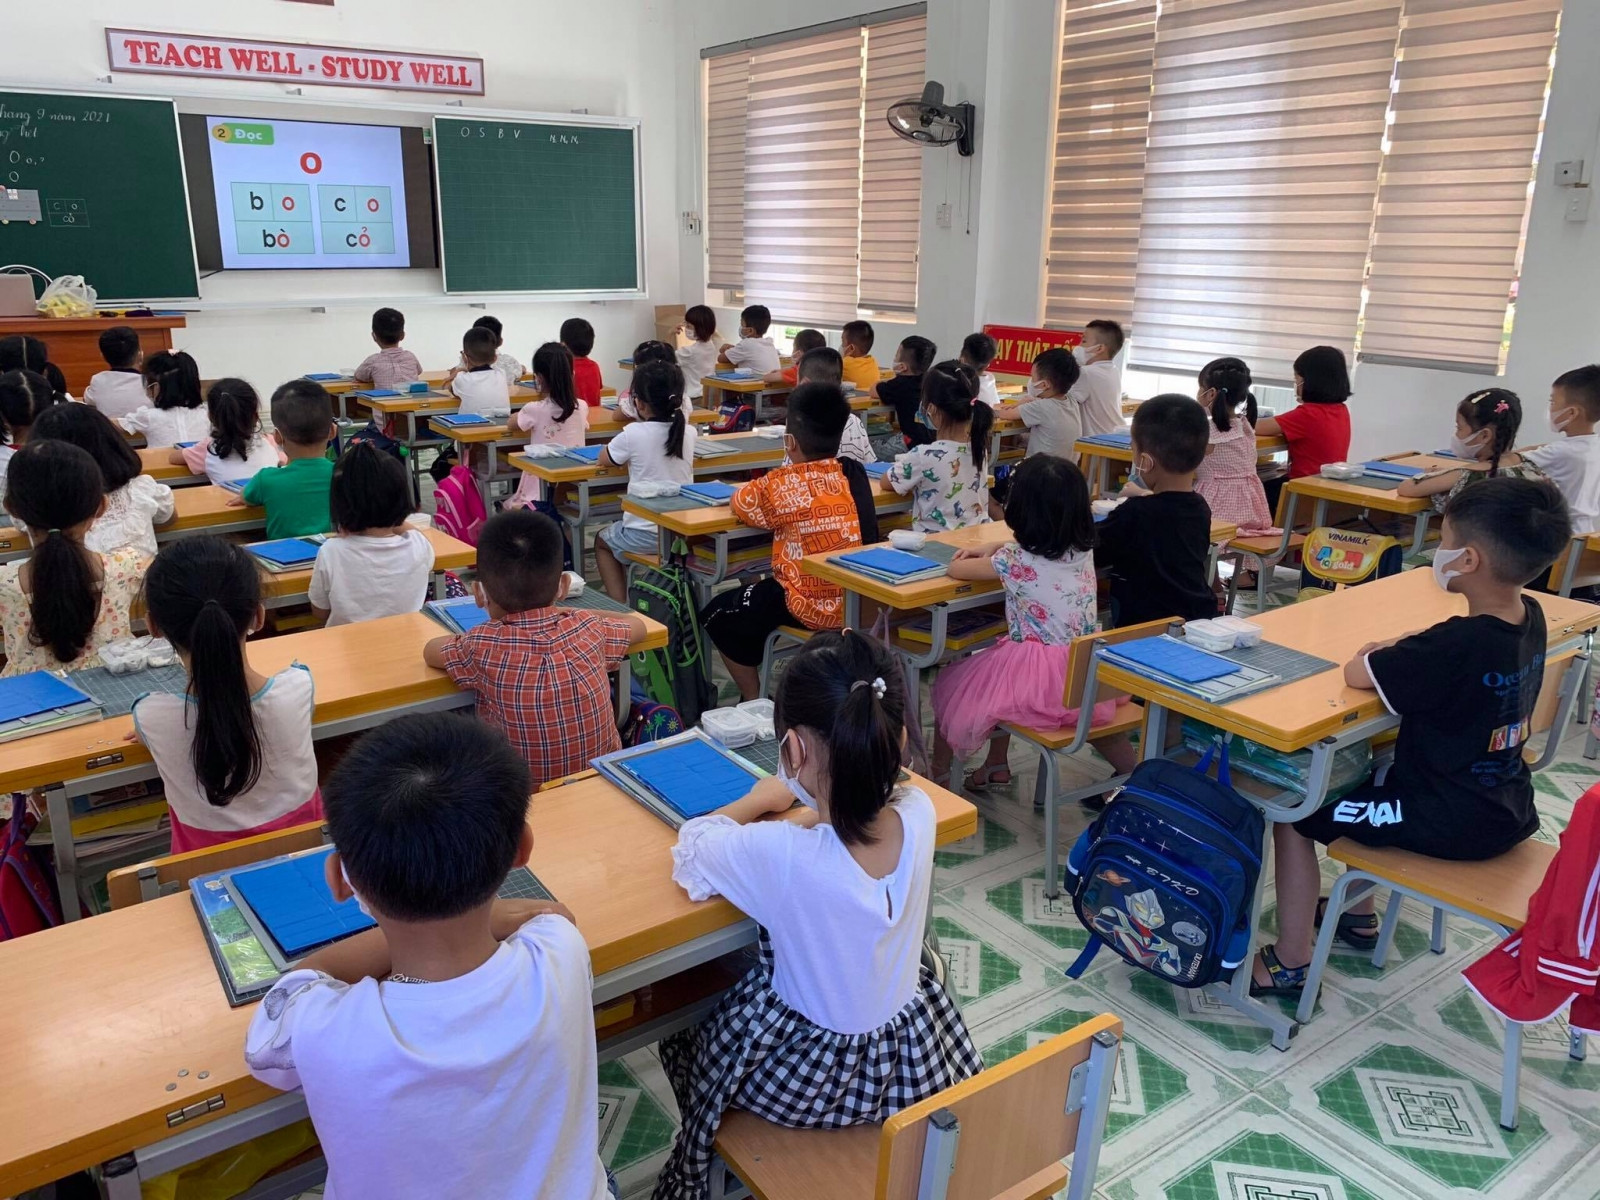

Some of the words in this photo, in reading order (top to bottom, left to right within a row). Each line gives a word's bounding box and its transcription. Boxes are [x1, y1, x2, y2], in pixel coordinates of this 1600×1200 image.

[124, 39, 223, 70] TEACH
[228, 48, 303, 75] WELL
[321, 55, 404, 82] STUDY
[409, 62, 473, 87] WELL
[36, 108, 46, 120] 9
[82, 111, 111, 123] 2021
[217, 128, 226, 138] 2
[234, 129, 263, 142] Đọc
[460, 127, 470, 138] O
[479, 127, 486, 138] S
[498, 128, 504, 139] B
[513, 129, 521, 139] V
[250, 191, 264, 210] b
[262, 228, 290, 248] bò
[345, 226, 371, 248] cỏ
[800, 523, 842, 533] MINIATURE
[1328, 532, 1371, 546] VINAMILK
